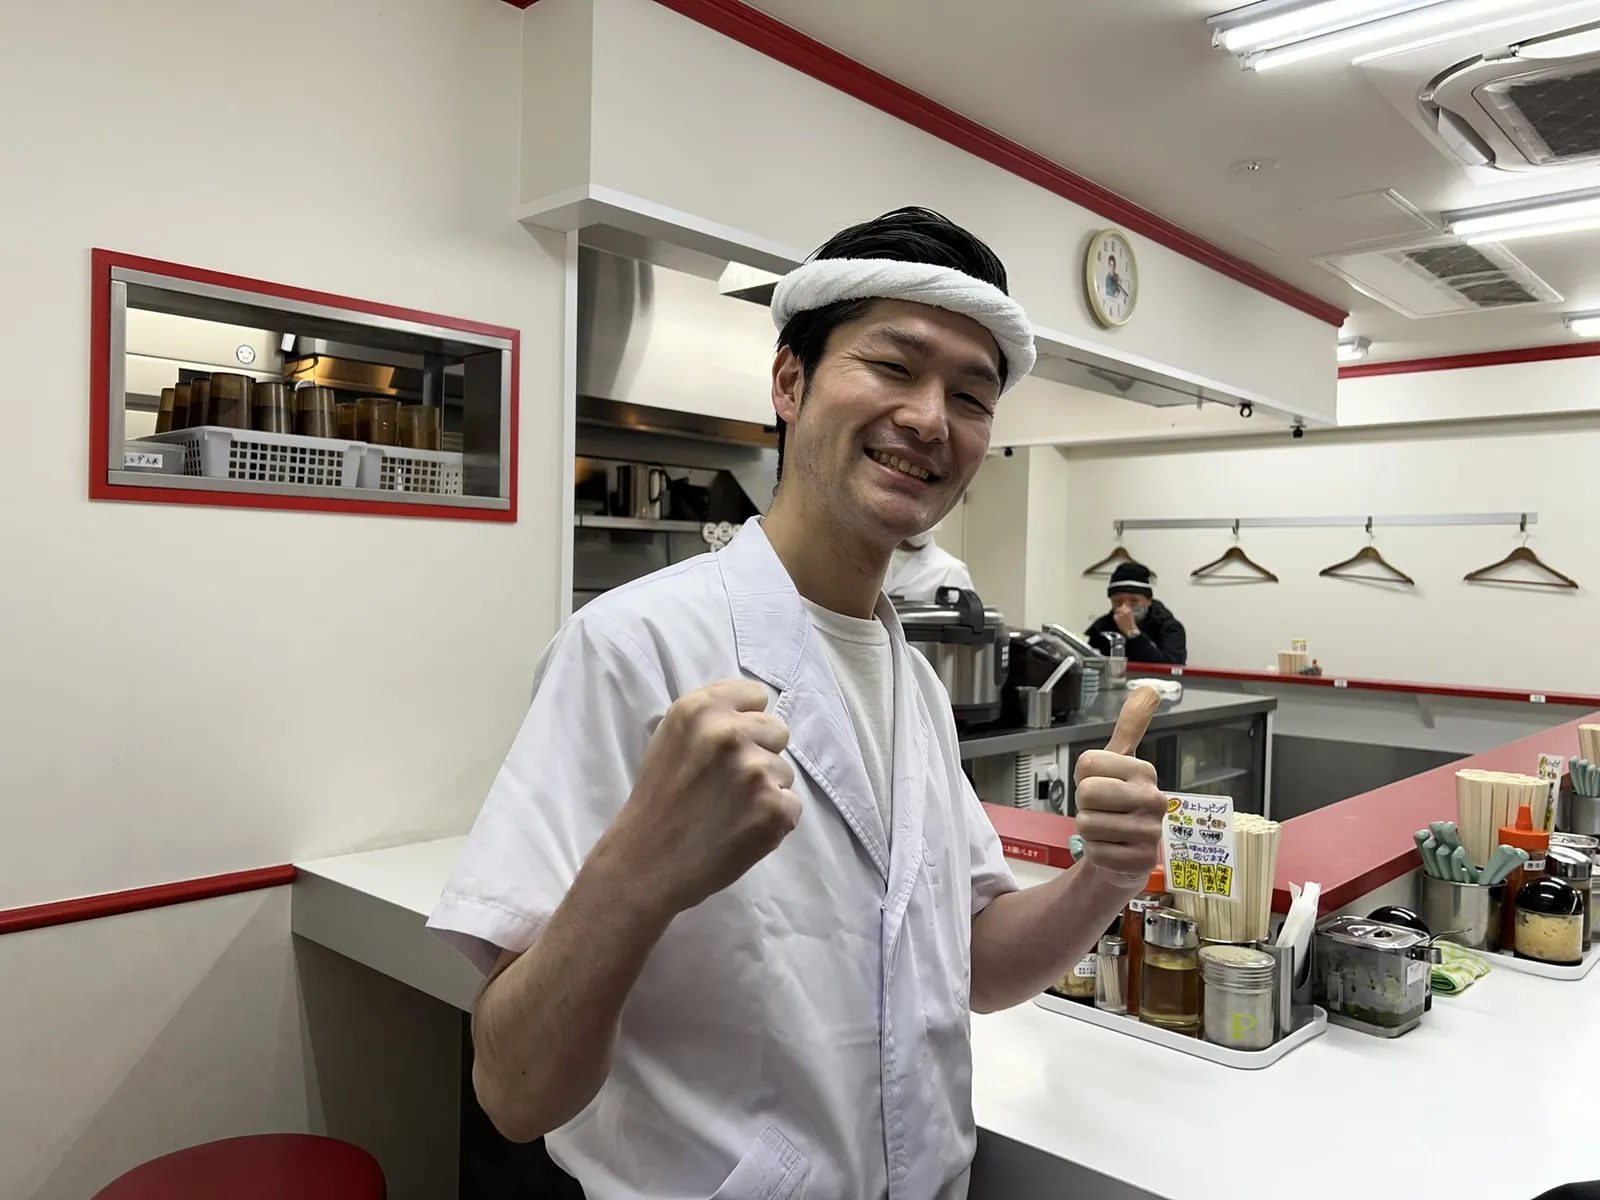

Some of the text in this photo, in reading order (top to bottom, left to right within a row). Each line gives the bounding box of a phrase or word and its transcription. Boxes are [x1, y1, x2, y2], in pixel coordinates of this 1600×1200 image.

[1182, 800, 1228, 814] 卓上トッピング
[1172, 861, 1183, 886] 油なし
[1229, 1012, 1256, 1039] P
